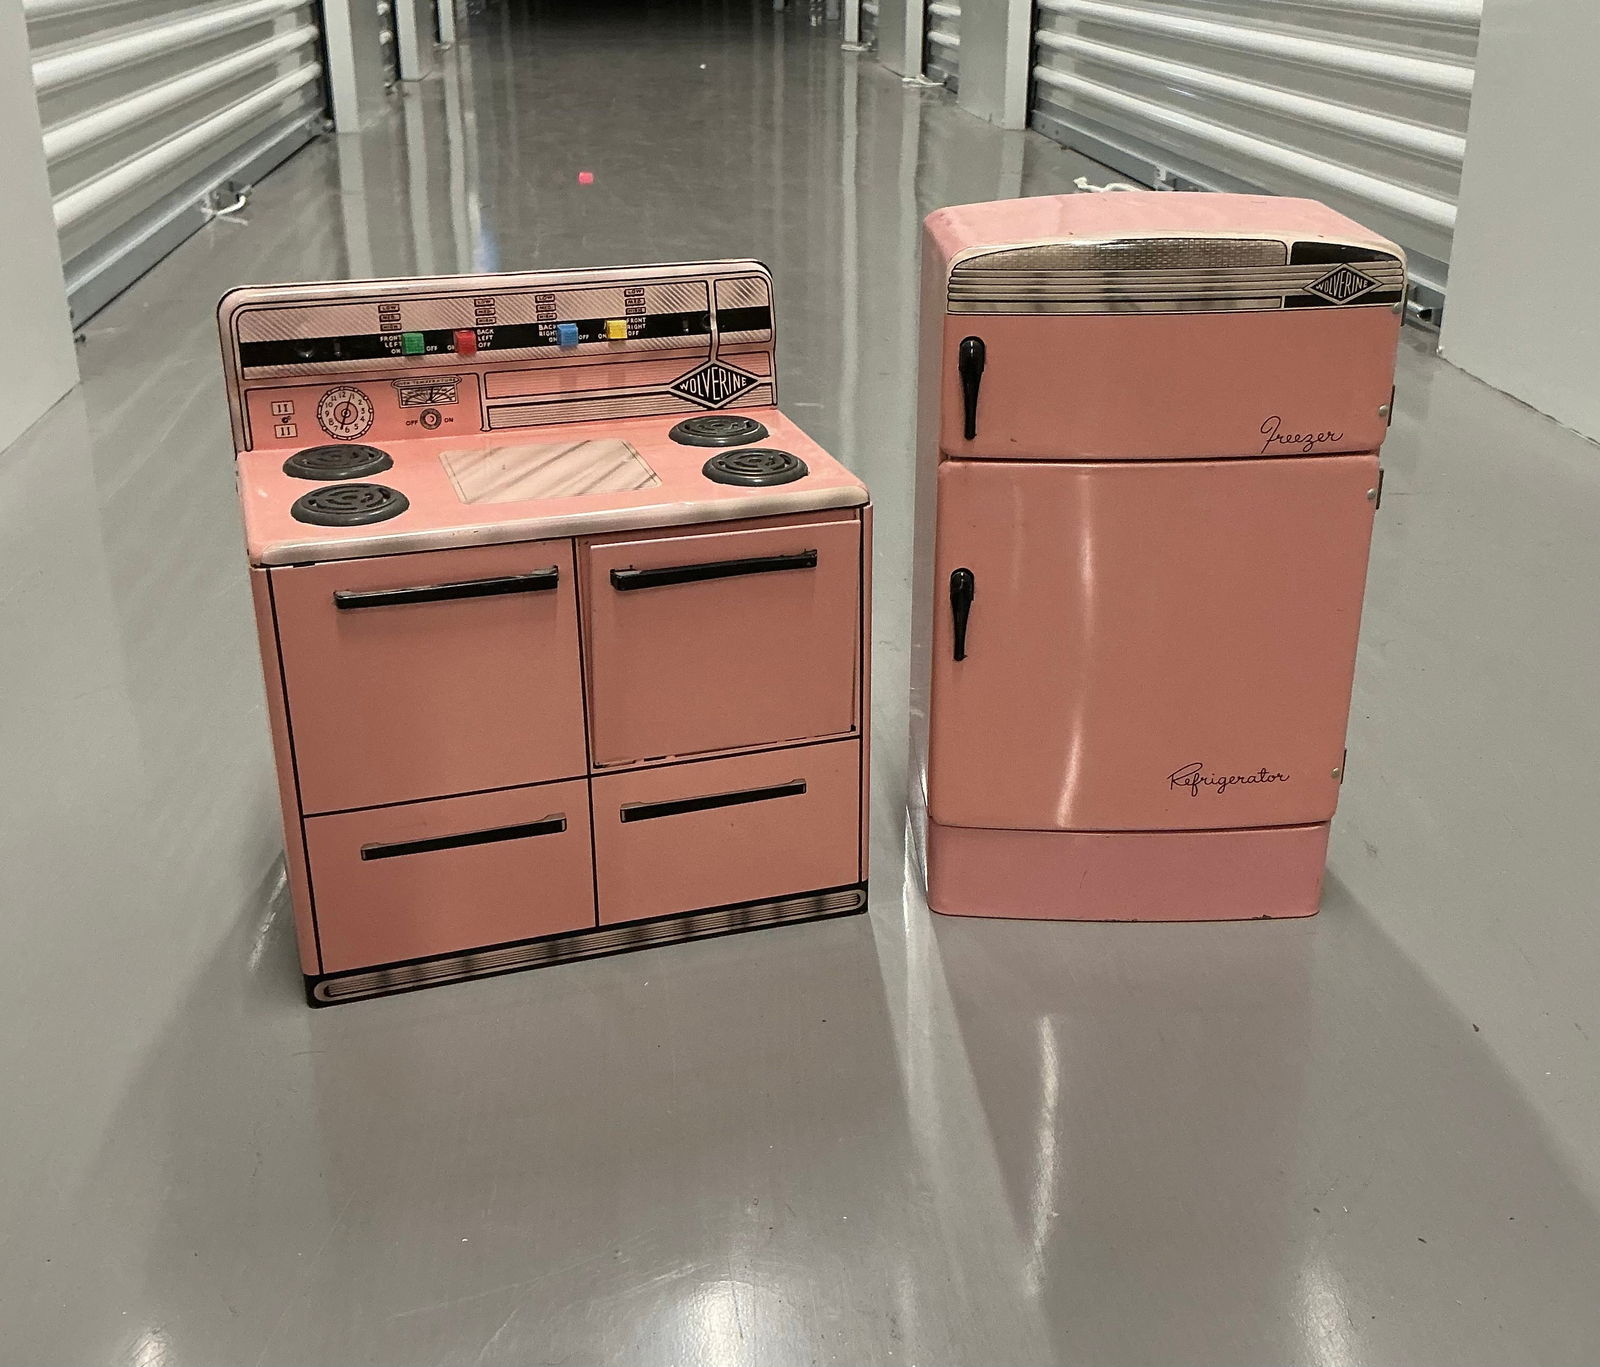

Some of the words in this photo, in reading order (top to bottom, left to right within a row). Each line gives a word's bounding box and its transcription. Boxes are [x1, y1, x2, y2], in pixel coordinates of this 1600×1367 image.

[1315, 270, 1369, 298] WOLVERINE
[680, 366, 747, 400] WOLVERINE
[1260, 415, 1344, 454] Freezer
[1166, 762, 1290, 797] Refrigerator
